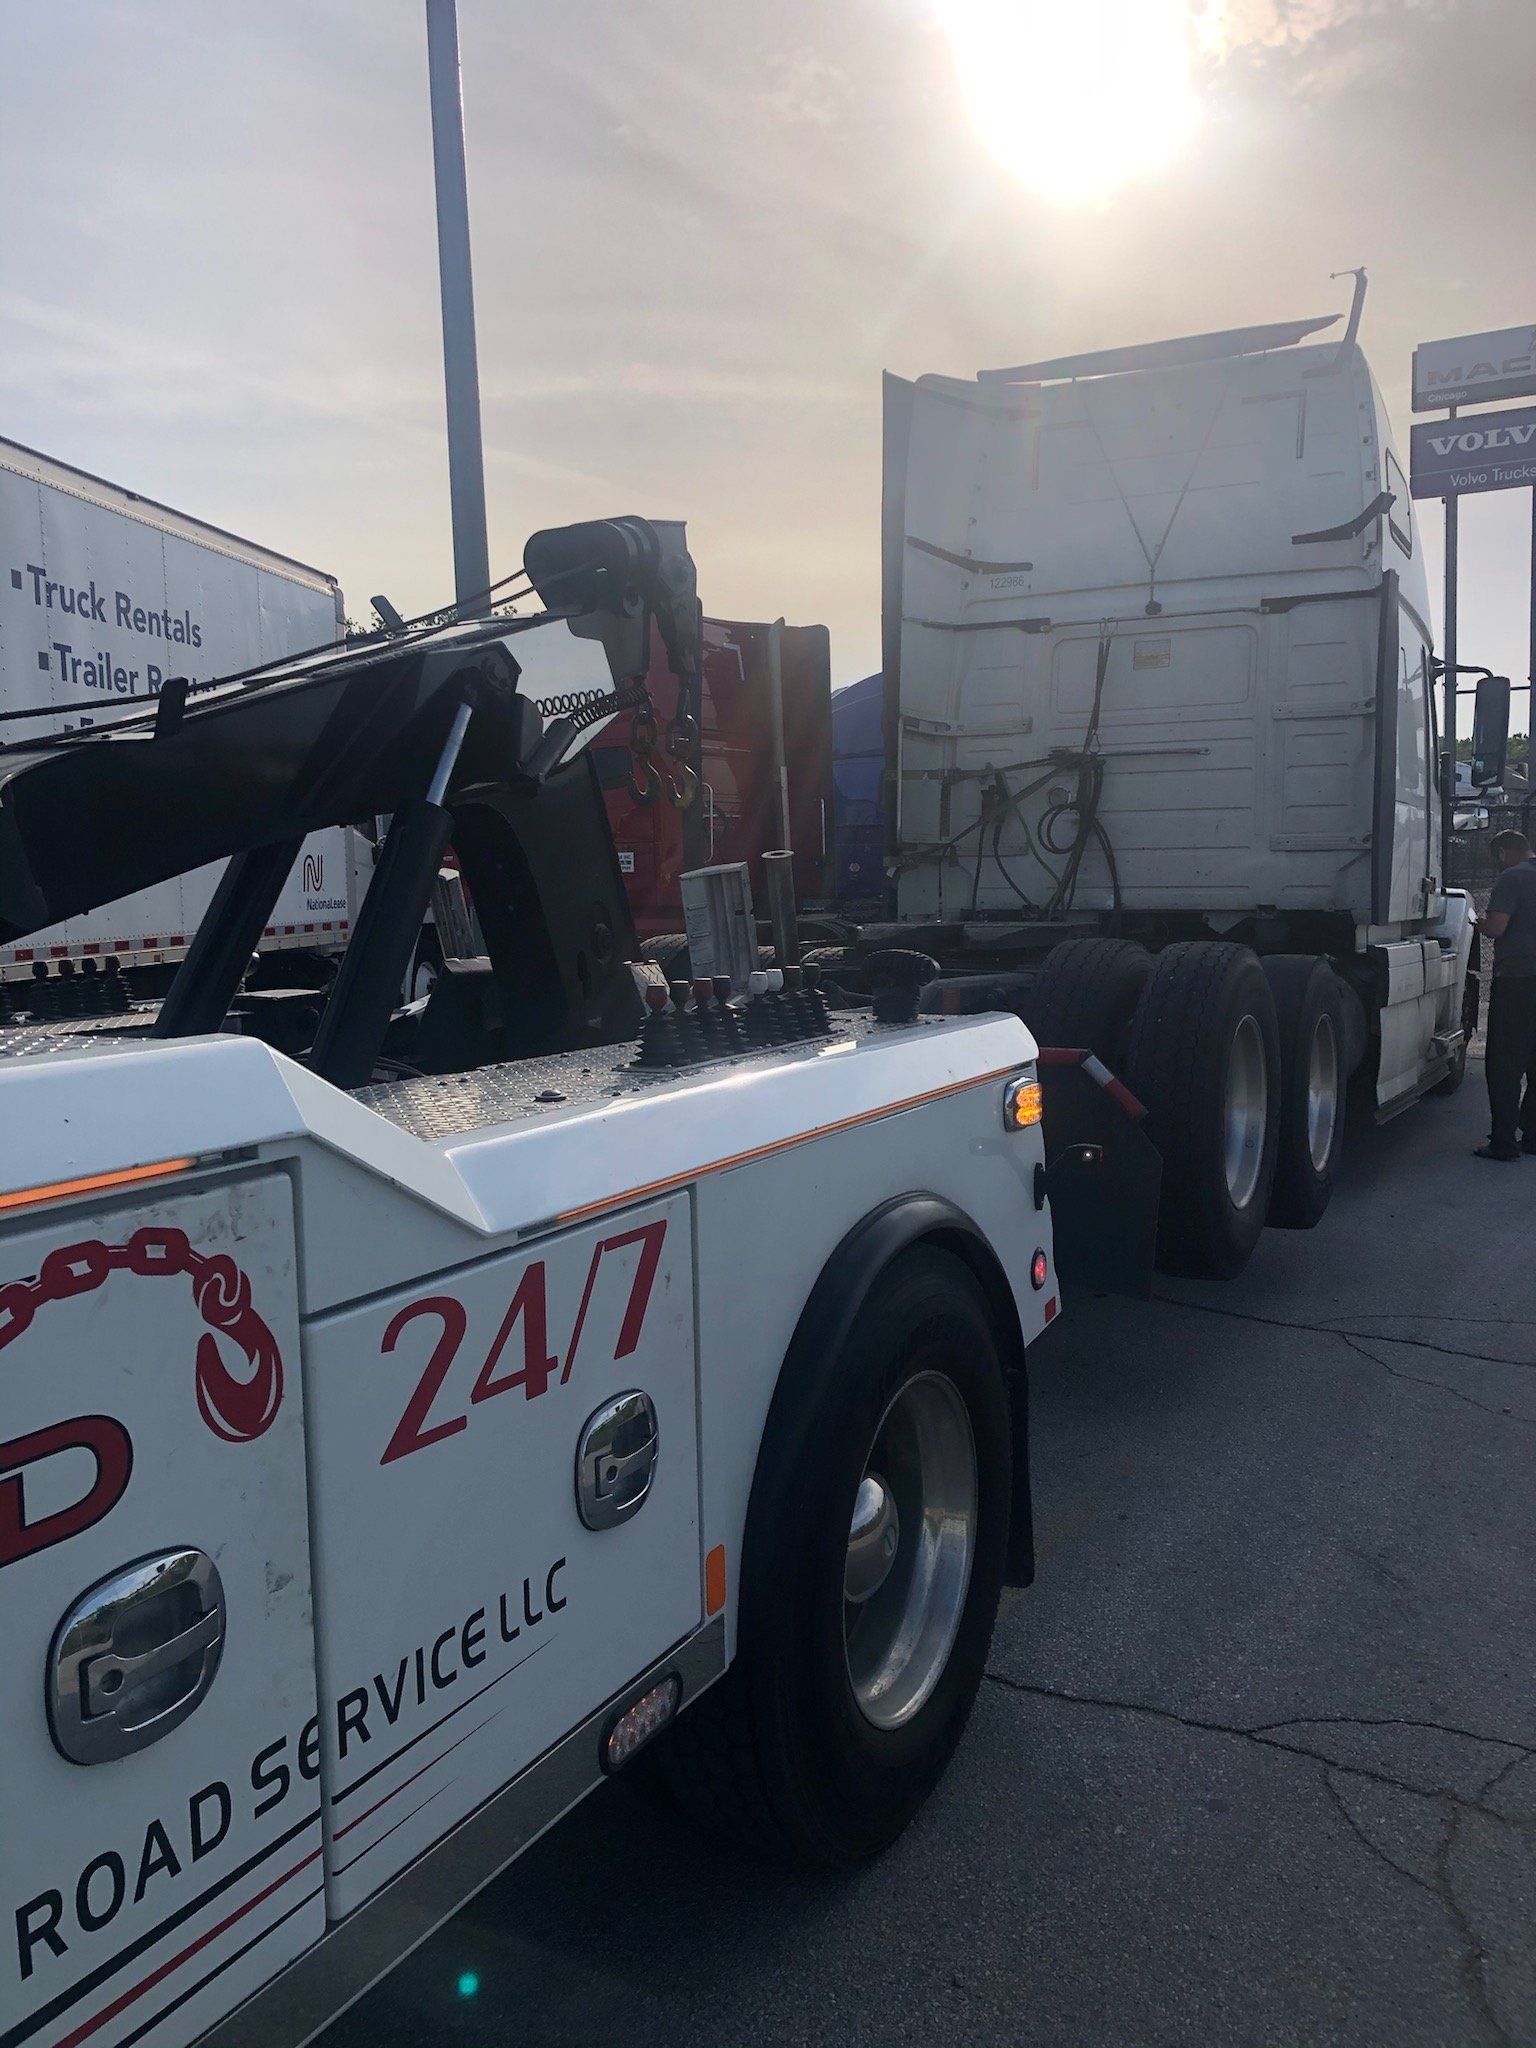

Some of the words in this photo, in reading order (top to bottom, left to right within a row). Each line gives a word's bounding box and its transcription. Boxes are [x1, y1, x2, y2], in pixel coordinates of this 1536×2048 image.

[1428, 390, 1468, 403] Chicago
[1450, 472, 1487, 487] Volvo
[1492, 465, 1536, 482] Trucks
[27, 563, 107, 623] Truck
[115, 591, 202, 649] Rentals
[53, 642, 139, 695] Trailer
[380, 1219, 668, 1466] 24/7
[15, 1781, 232, 1981] ROAD
[251, 1607, 487, 1820] SERVICE
[500, 1556, 567, 1643] LLC
